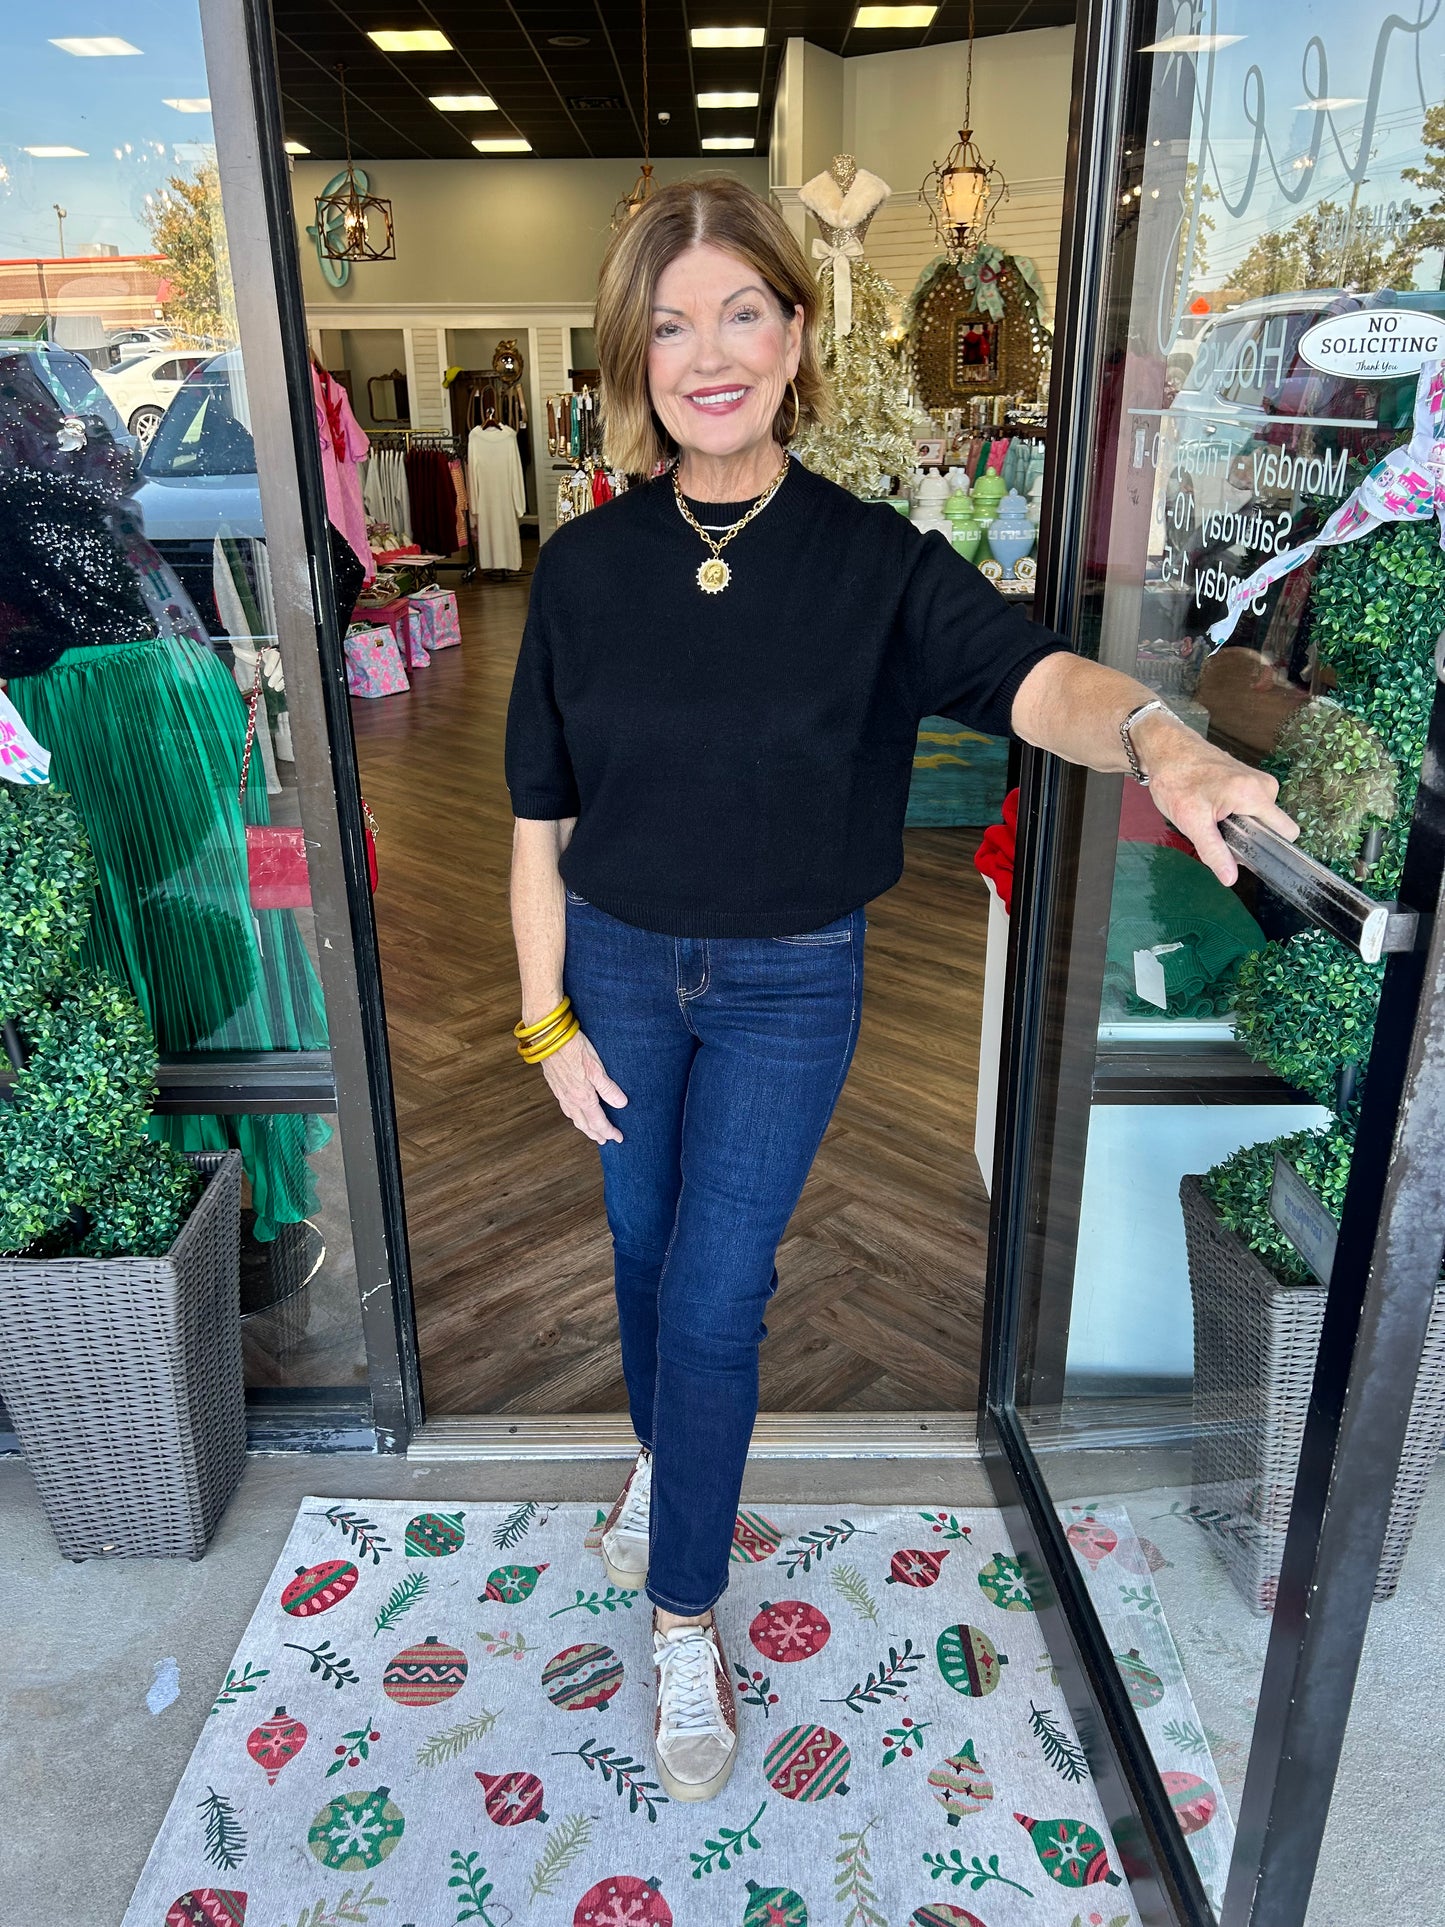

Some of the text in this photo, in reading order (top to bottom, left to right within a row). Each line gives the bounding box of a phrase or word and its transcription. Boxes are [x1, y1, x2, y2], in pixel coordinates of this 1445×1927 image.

[1368, 317, 1398, 333] NO
[1321, 336, 1438, 354] SOLICITING
[1355, 359, 1398, 373] Thank You
